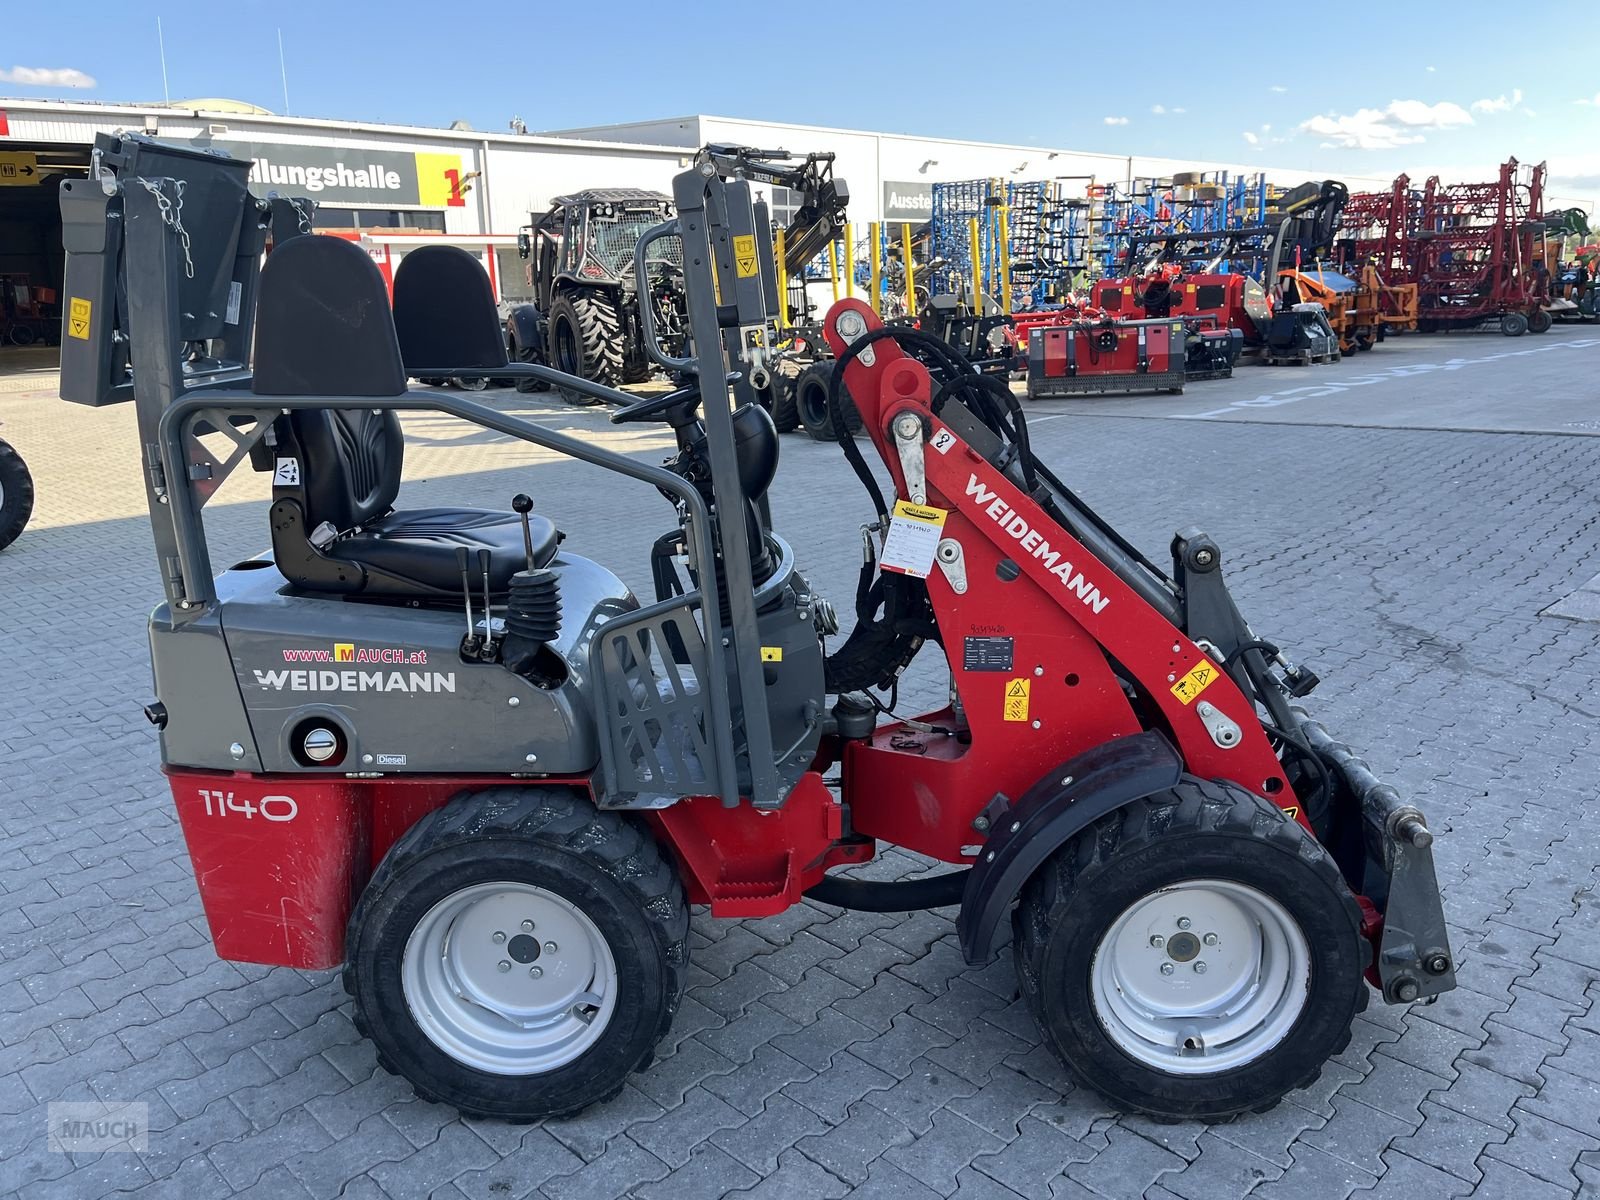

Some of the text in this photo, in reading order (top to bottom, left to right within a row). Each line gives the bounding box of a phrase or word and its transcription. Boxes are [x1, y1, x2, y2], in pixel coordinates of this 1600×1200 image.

[444, 169, 466, 207] 1
[965, 473, 1110, 614] WEIDEMANN
[283, 648, 427, 665] www.MAUCH.at
[253, 669, 456, 693] WEIDEMANN
[379, 755, 405, 764] Diesel
[198, 790, 298, 821] 1140
